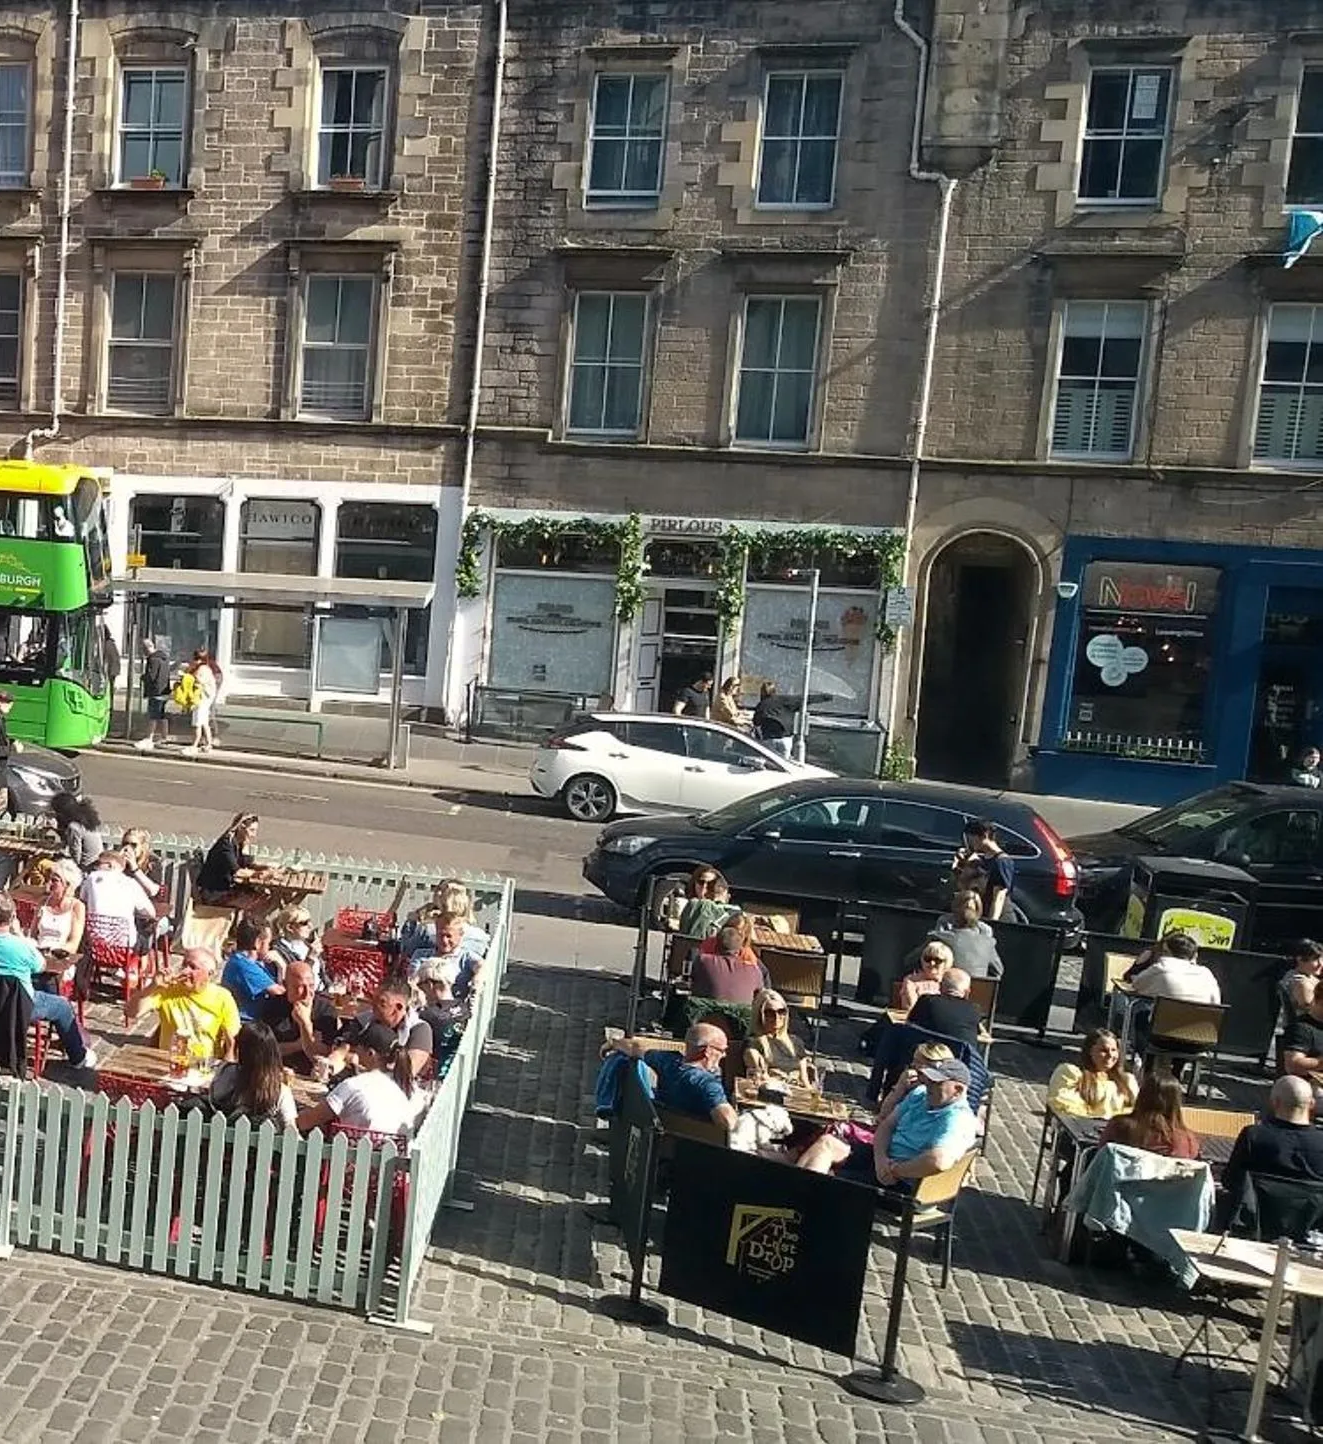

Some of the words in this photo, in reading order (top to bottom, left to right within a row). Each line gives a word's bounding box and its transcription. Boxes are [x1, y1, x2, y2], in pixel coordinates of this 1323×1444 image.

[651, 518, 723, 534] PIRLOUS
[772, 1217, 798, 1242] The
[749, 1241, 795, 1272] Drop
